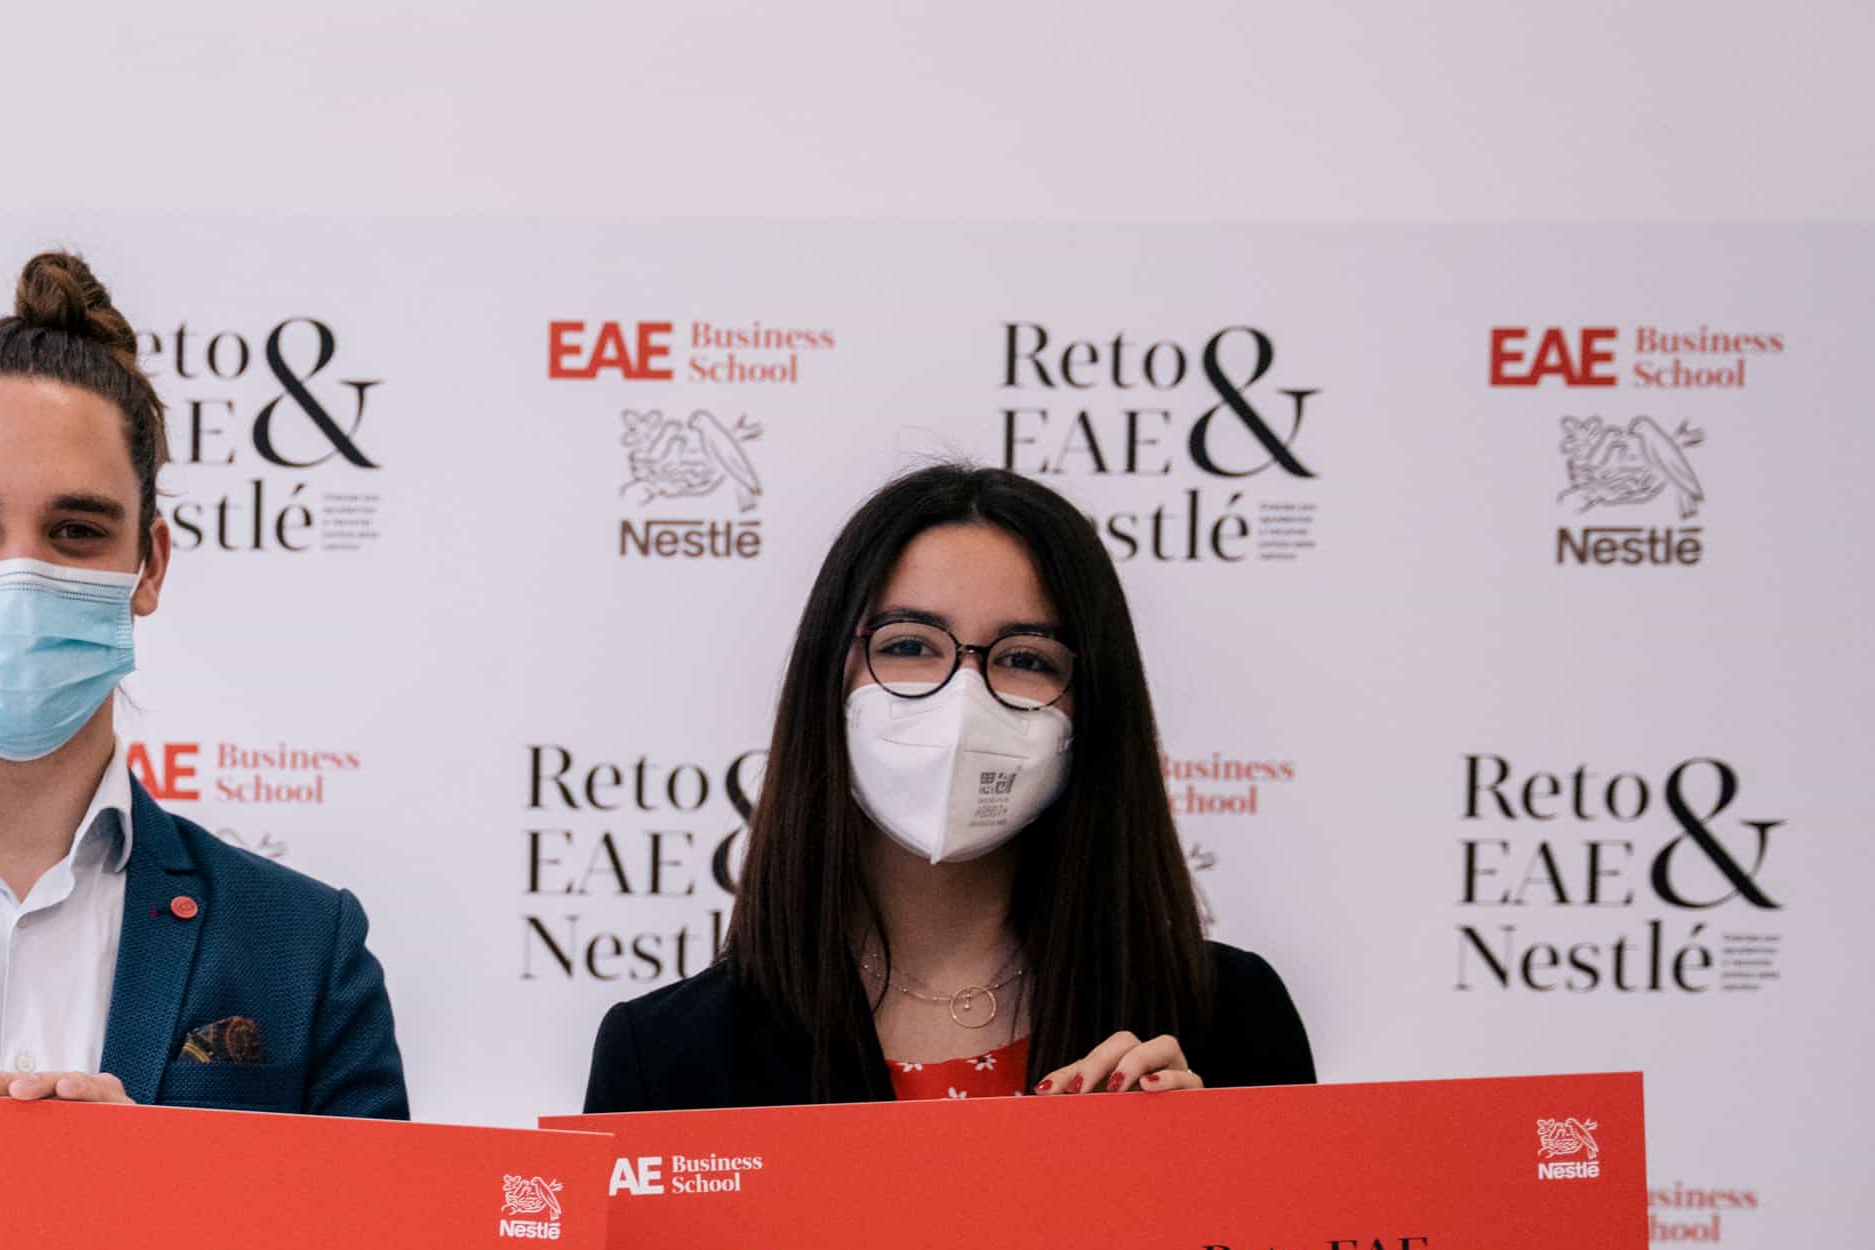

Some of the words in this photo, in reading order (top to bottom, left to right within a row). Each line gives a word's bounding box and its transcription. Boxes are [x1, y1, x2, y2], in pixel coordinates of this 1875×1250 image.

[548, 321, 673, 380] EAE
[691, 322, 834, 350] Business
[688, 353, 798, 384] School
[1002, 322, 1188, 391] Reto
[1489, 327, 1618, 387] EAE
[252, 316, 385, 468] &
[1187, 326, 1324, 479] &
[619, 519, 762, 558] Nestlé
[1557, 527, 1703, 565] Nestlé
[526, 745, 709, 811] Reto
[1461, 753, 1651, 822] Reto
[524, 829, 695, 896] EAE
[1650, 757, 1788, 912] &
[1458, 838, 1635, 907] EAE
[1455, 918, 1713, 993] Nestlé
[672, 1153, 762, 1173] Business
[672, 1173, 741, 1194] School
[1539, 1160, 1599, 1179] Nestlé
[500, 1220, 560, 1239] Nestlé
